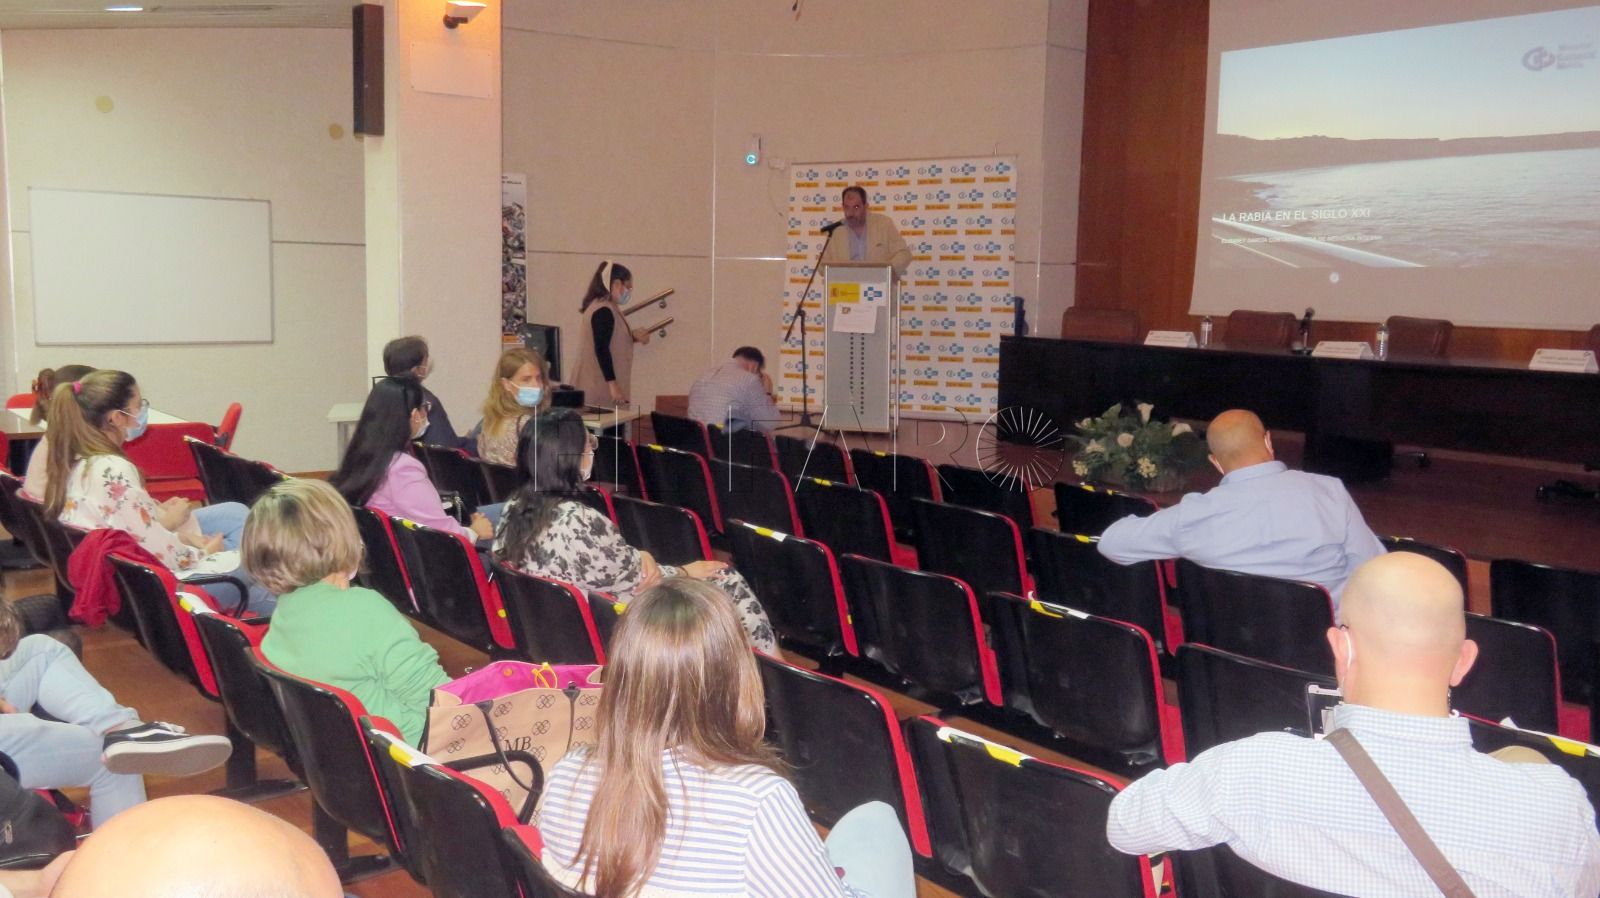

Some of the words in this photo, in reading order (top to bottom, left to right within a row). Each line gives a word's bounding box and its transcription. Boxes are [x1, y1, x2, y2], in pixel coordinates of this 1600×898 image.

[1222, 212, 1236, 222] LA
[1240, 211, 1271, 222] RABIA
[1275, 210, 1290, 221] EN
[1295, 209, 1307, 220] EL
[1311, 208, 1347, 220] SIGLO
[1351, 207, 1371, 218] XXI
